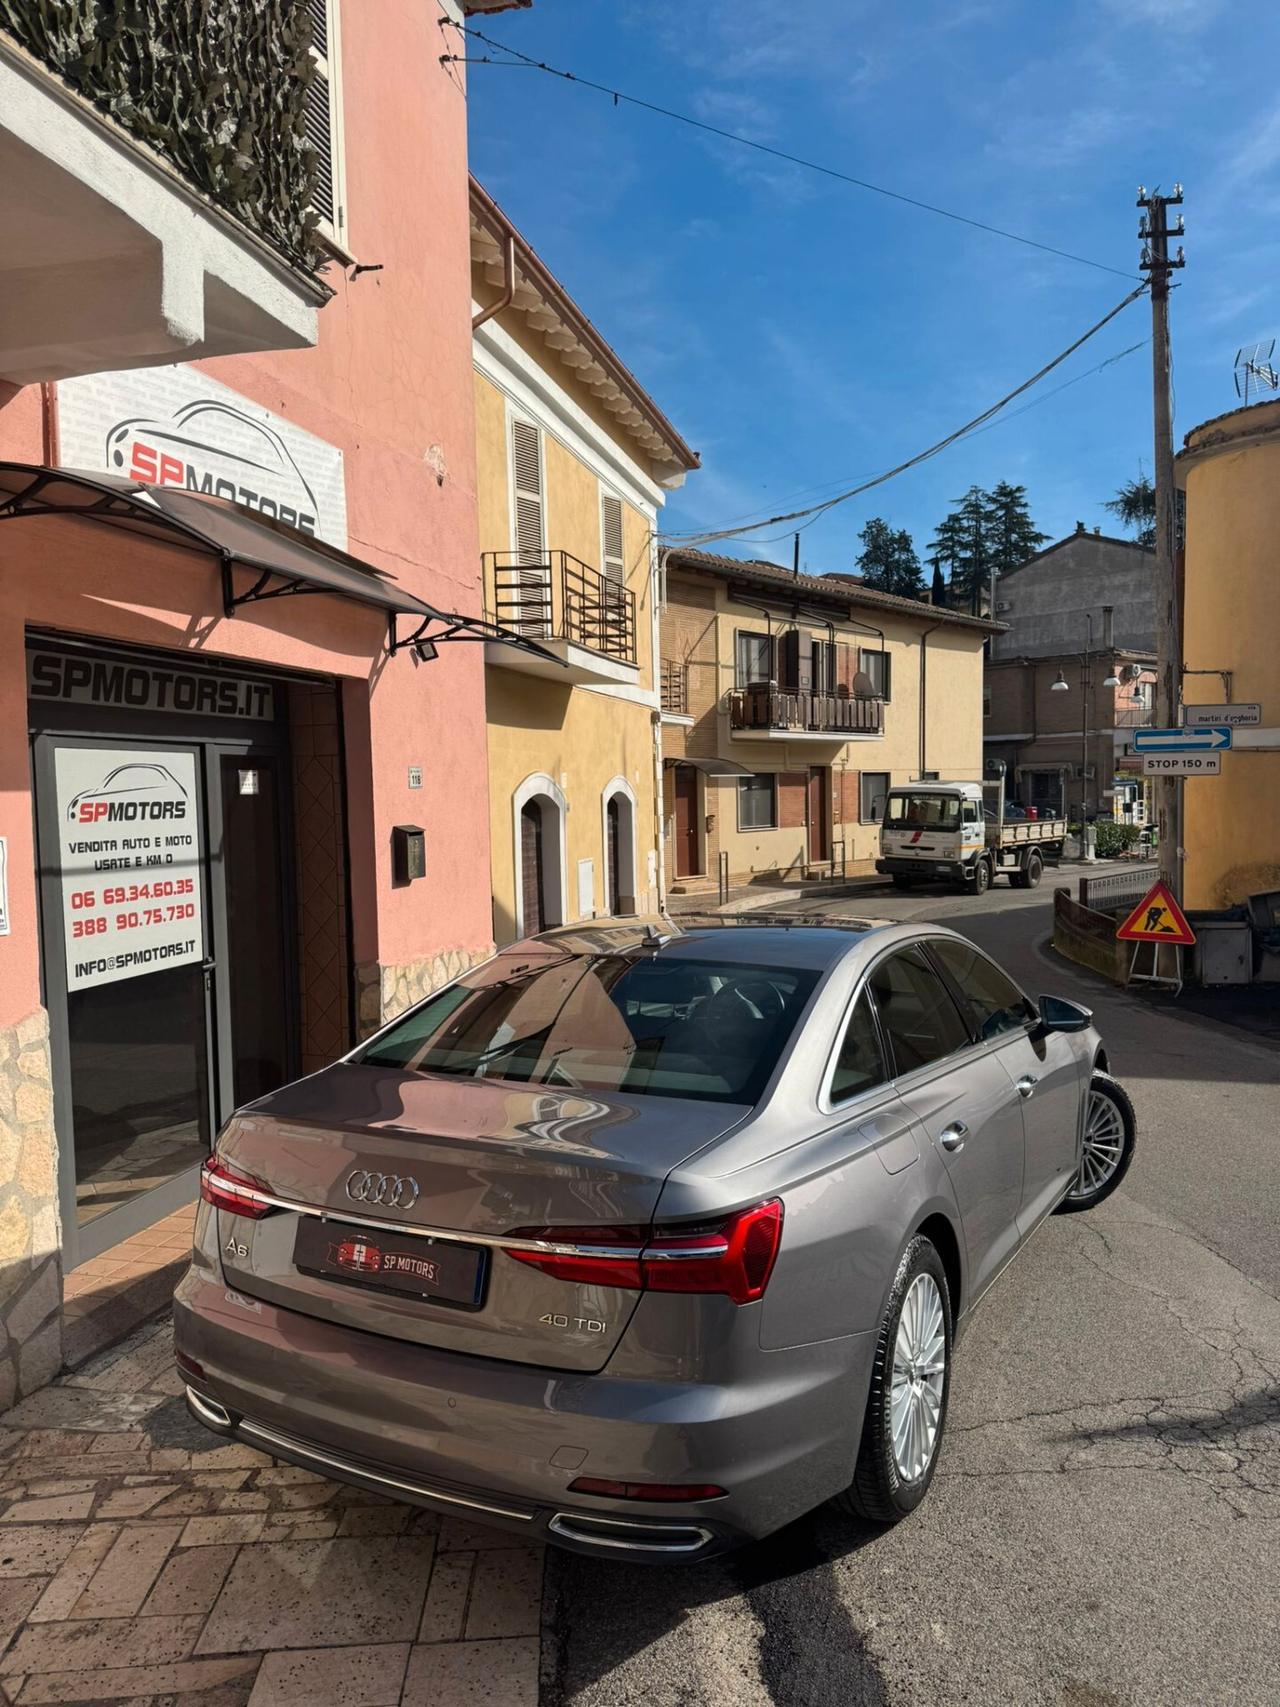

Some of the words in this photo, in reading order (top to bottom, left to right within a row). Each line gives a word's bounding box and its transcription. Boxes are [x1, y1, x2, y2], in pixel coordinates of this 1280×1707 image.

[32, 655, 270, 718] SPMOTORS.IT
[1147, 760, 1179, 768] STOP
[1182, 759, 1202, 768] 150
[1206, 760, 1216, 768] m
[78, 799, 186, 824] SPMOTORS
[68, 837, 119, 855] VENDITA
[122, 836, 150, 850] AUTO
[154, 836, 161, 848] E
[165, 834, 193, 847] MOTO
[94, 857, 131, 872] USATE
[135, 855, 142, 867] E
[146, 853, 163, 866] KM
[71, 890, 95, 910] 06
[103, 879, 194, 907] 69.34.60.35
[72, 916, 108, 938] 388
[116, 904, 196, 931] 90.75.730
[75, 940, 196, 978] INFO@SPMOTORS.IT
[225, 1237, 249, 1257] A6
[383, 1254, 397, 1270] SP
[397, 1256, 435, 1280] MOTORS
[538, 1313, 568, 1327] 40
[574, 1317, 607, 1333] TDI
